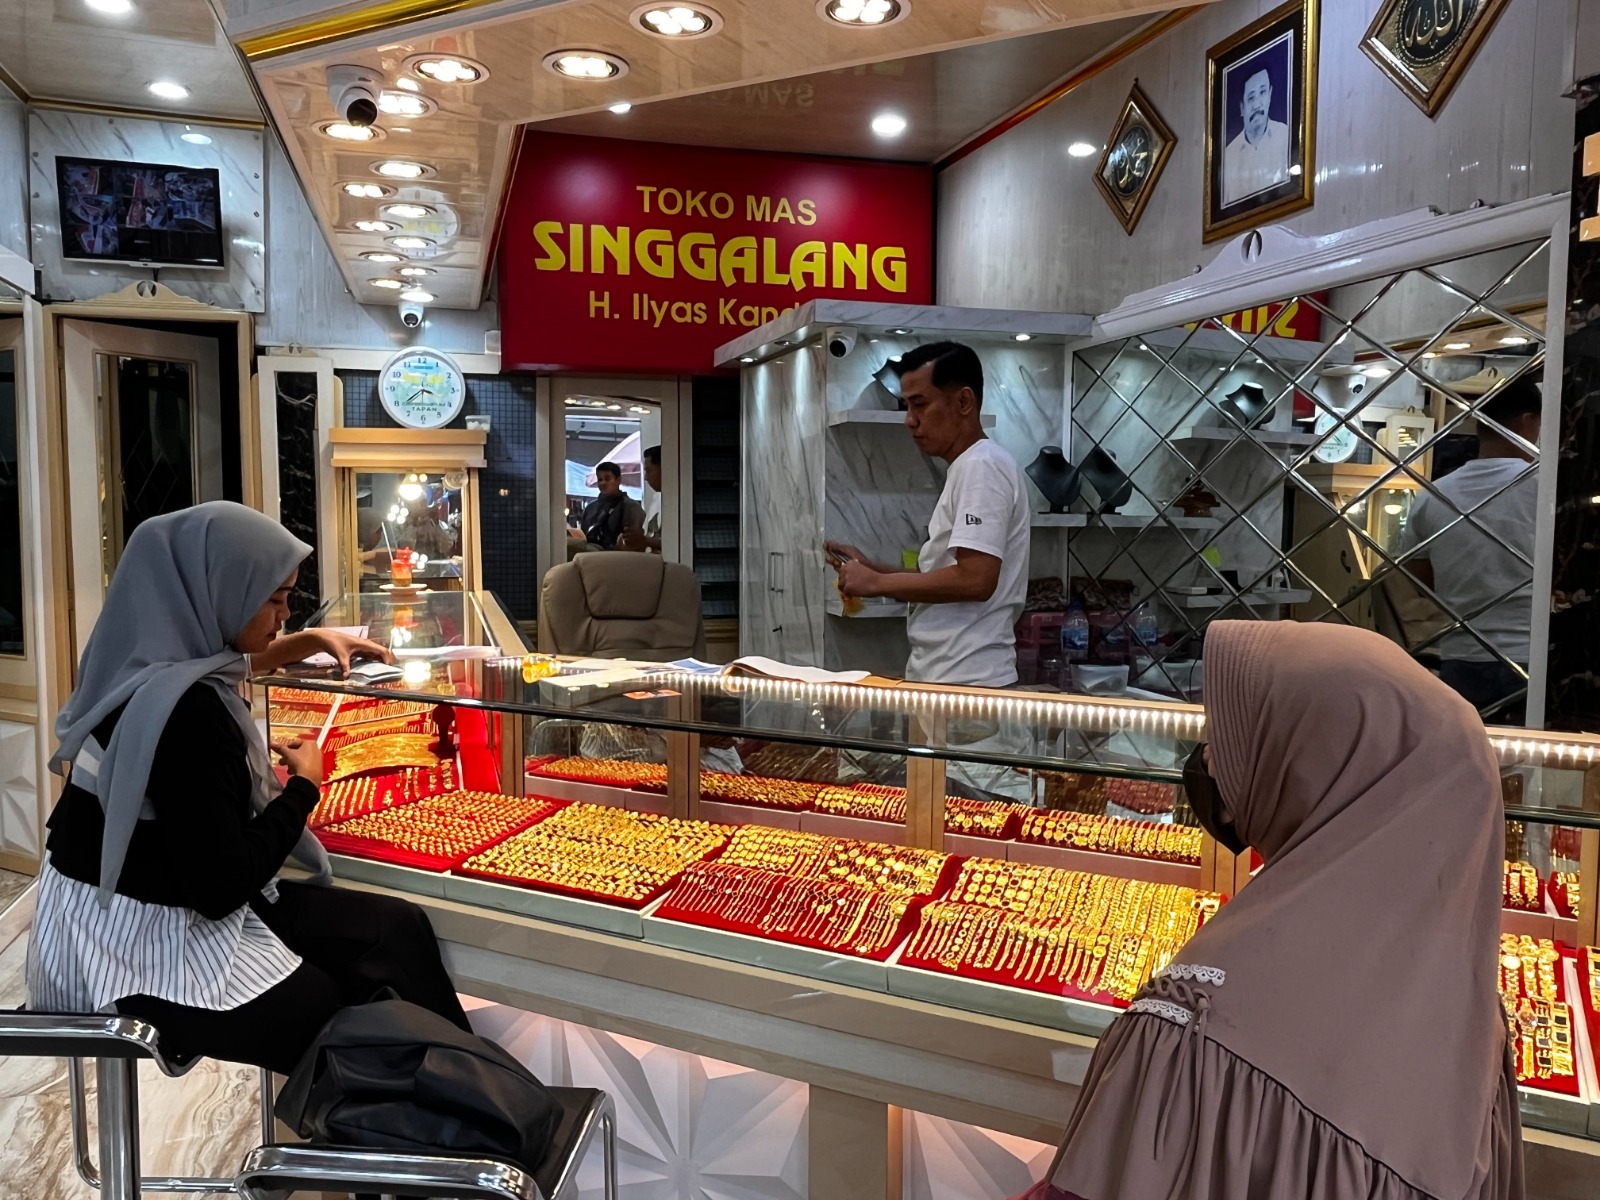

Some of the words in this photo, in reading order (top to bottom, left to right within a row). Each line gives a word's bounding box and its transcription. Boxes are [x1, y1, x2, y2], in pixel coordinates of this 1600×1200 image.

[636, 185, 735, 220] TOKO
[746, 194, 817, 226] MAS
[532, 220, 908, 293] SINGGALANG
[589, 291, 619, 319] H.
[633, 293, 707, 328] Ilyas
